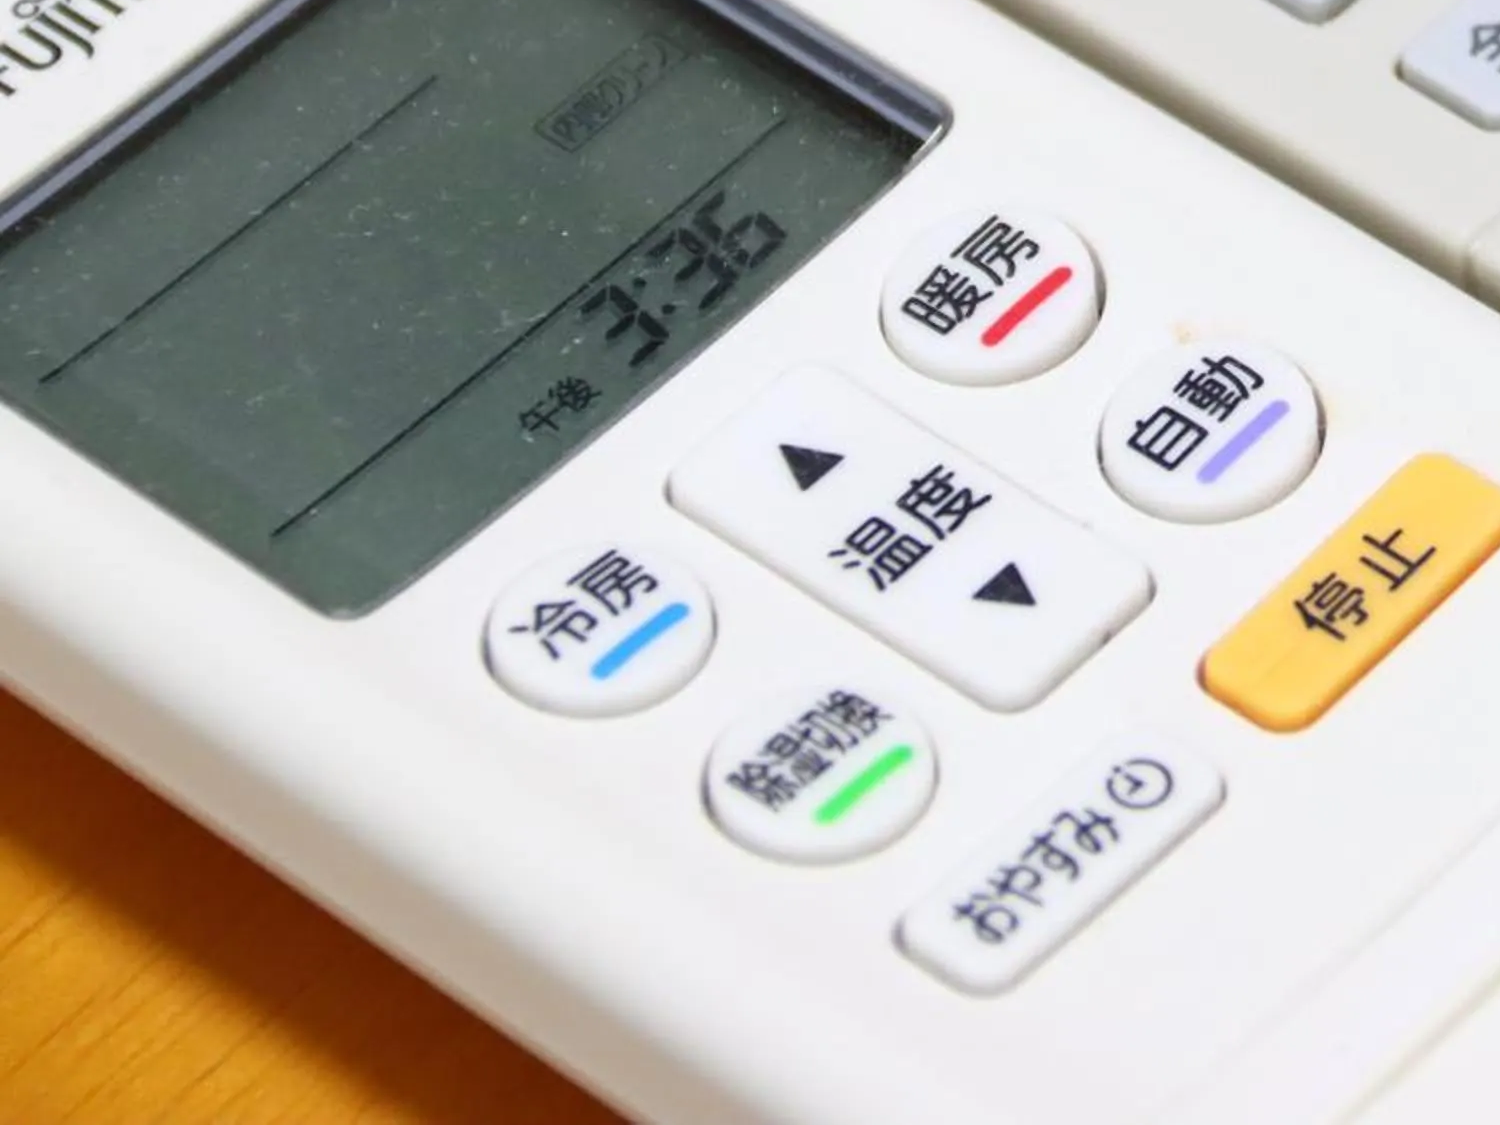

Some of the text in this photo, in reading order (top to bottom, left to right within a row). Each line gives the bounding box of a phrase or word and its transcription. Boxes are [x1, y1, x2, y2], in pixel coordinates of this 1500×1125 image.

[519, 190, 786, 431] 午後 3:36
[902, 213, 1041, 336] 暖房
[1128, 355, 1265, 472] 自動
[829, 464, 993, 592] 温度
[1293, 527, 1436, 642] 停止
[510, 550, 659, 661] 冷房
[726, 691, 895, 812] 除湿切換
[951, 806, 1121, 945] おやすみ
